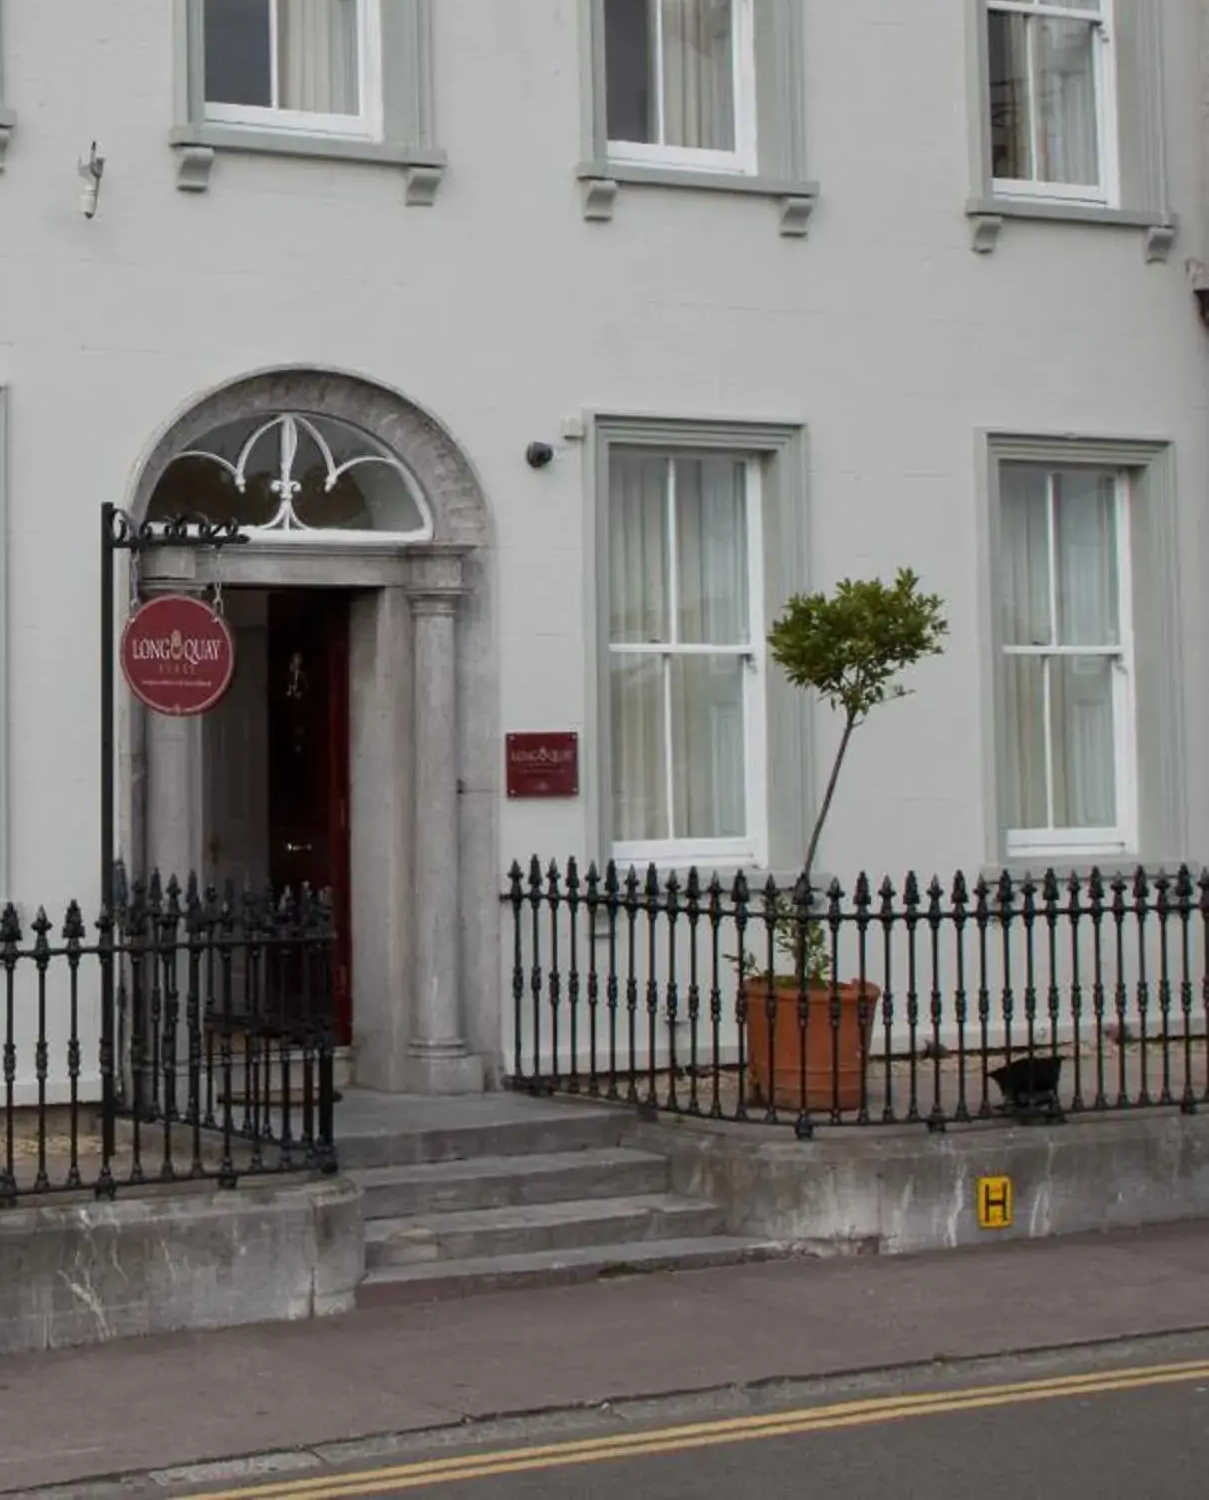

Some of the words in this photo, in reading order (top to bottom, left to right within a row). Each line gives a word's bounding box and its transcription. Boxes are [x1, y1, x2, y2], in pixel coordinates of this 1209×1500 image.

[132, 638, 170, 660] LONG
[184, 638, 222, 665] QUAY
[985, 1182, 1008, 1223] H
